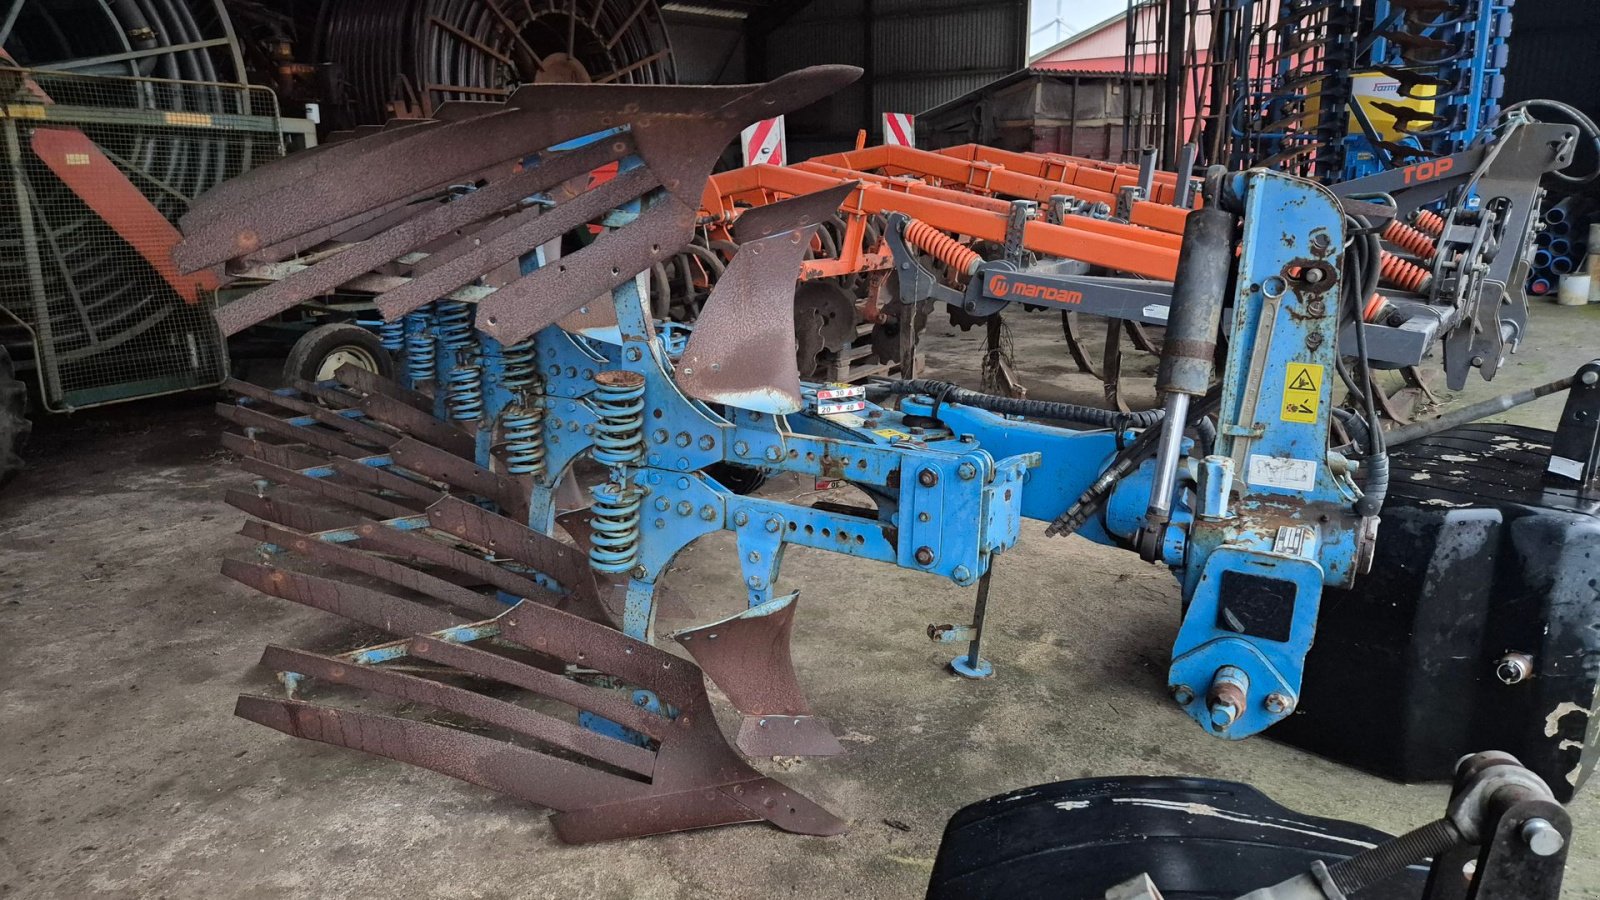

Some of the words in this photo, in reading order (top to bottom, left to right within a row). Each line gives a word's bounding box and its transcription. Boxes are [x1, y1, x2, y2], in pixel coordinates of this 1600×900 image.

[1373, 82, 1401, 92] Farm
[1403, 157, 1454, 186] TOP
[835, 389, 845, 397] 30
[821, 406, 831, 414] 20
